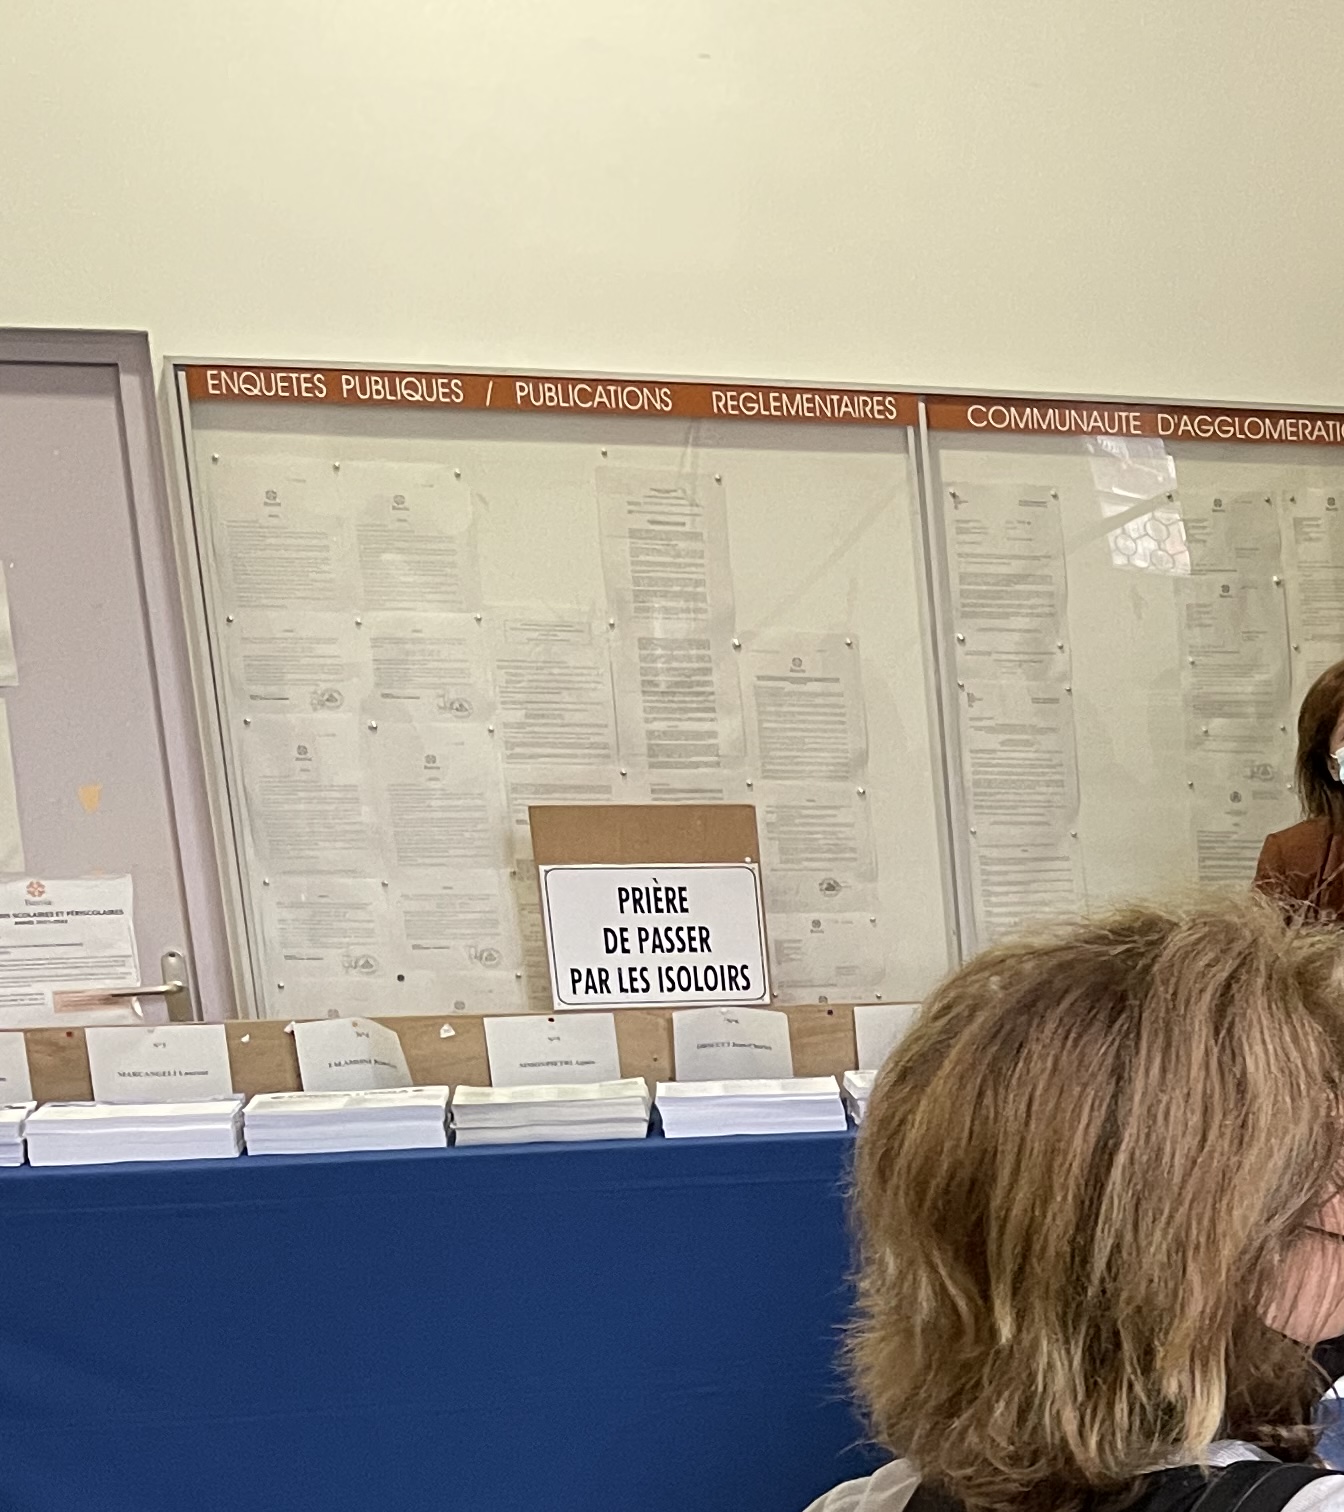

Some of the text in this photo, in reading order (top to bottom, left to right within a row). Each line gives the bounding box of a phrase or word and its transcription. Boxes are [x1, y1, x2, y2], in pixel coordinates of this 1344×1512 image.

[206, 370, 327, 399] ENQUETES
[341, 374, 464, 403] PUBLIQUES
[515, 381, 673, 411] PUBLICATIONS
[711, 390, 897, 420] REGLEMENTAIRES
[967, 404, 1143, 435] COMMUNAUTE
[617, 877, 690, 914] PRIÈRE
[603, 925, 713, 954] DE PASSER
[570, 964, 751, 995] PAR LES ISOLOIRS
